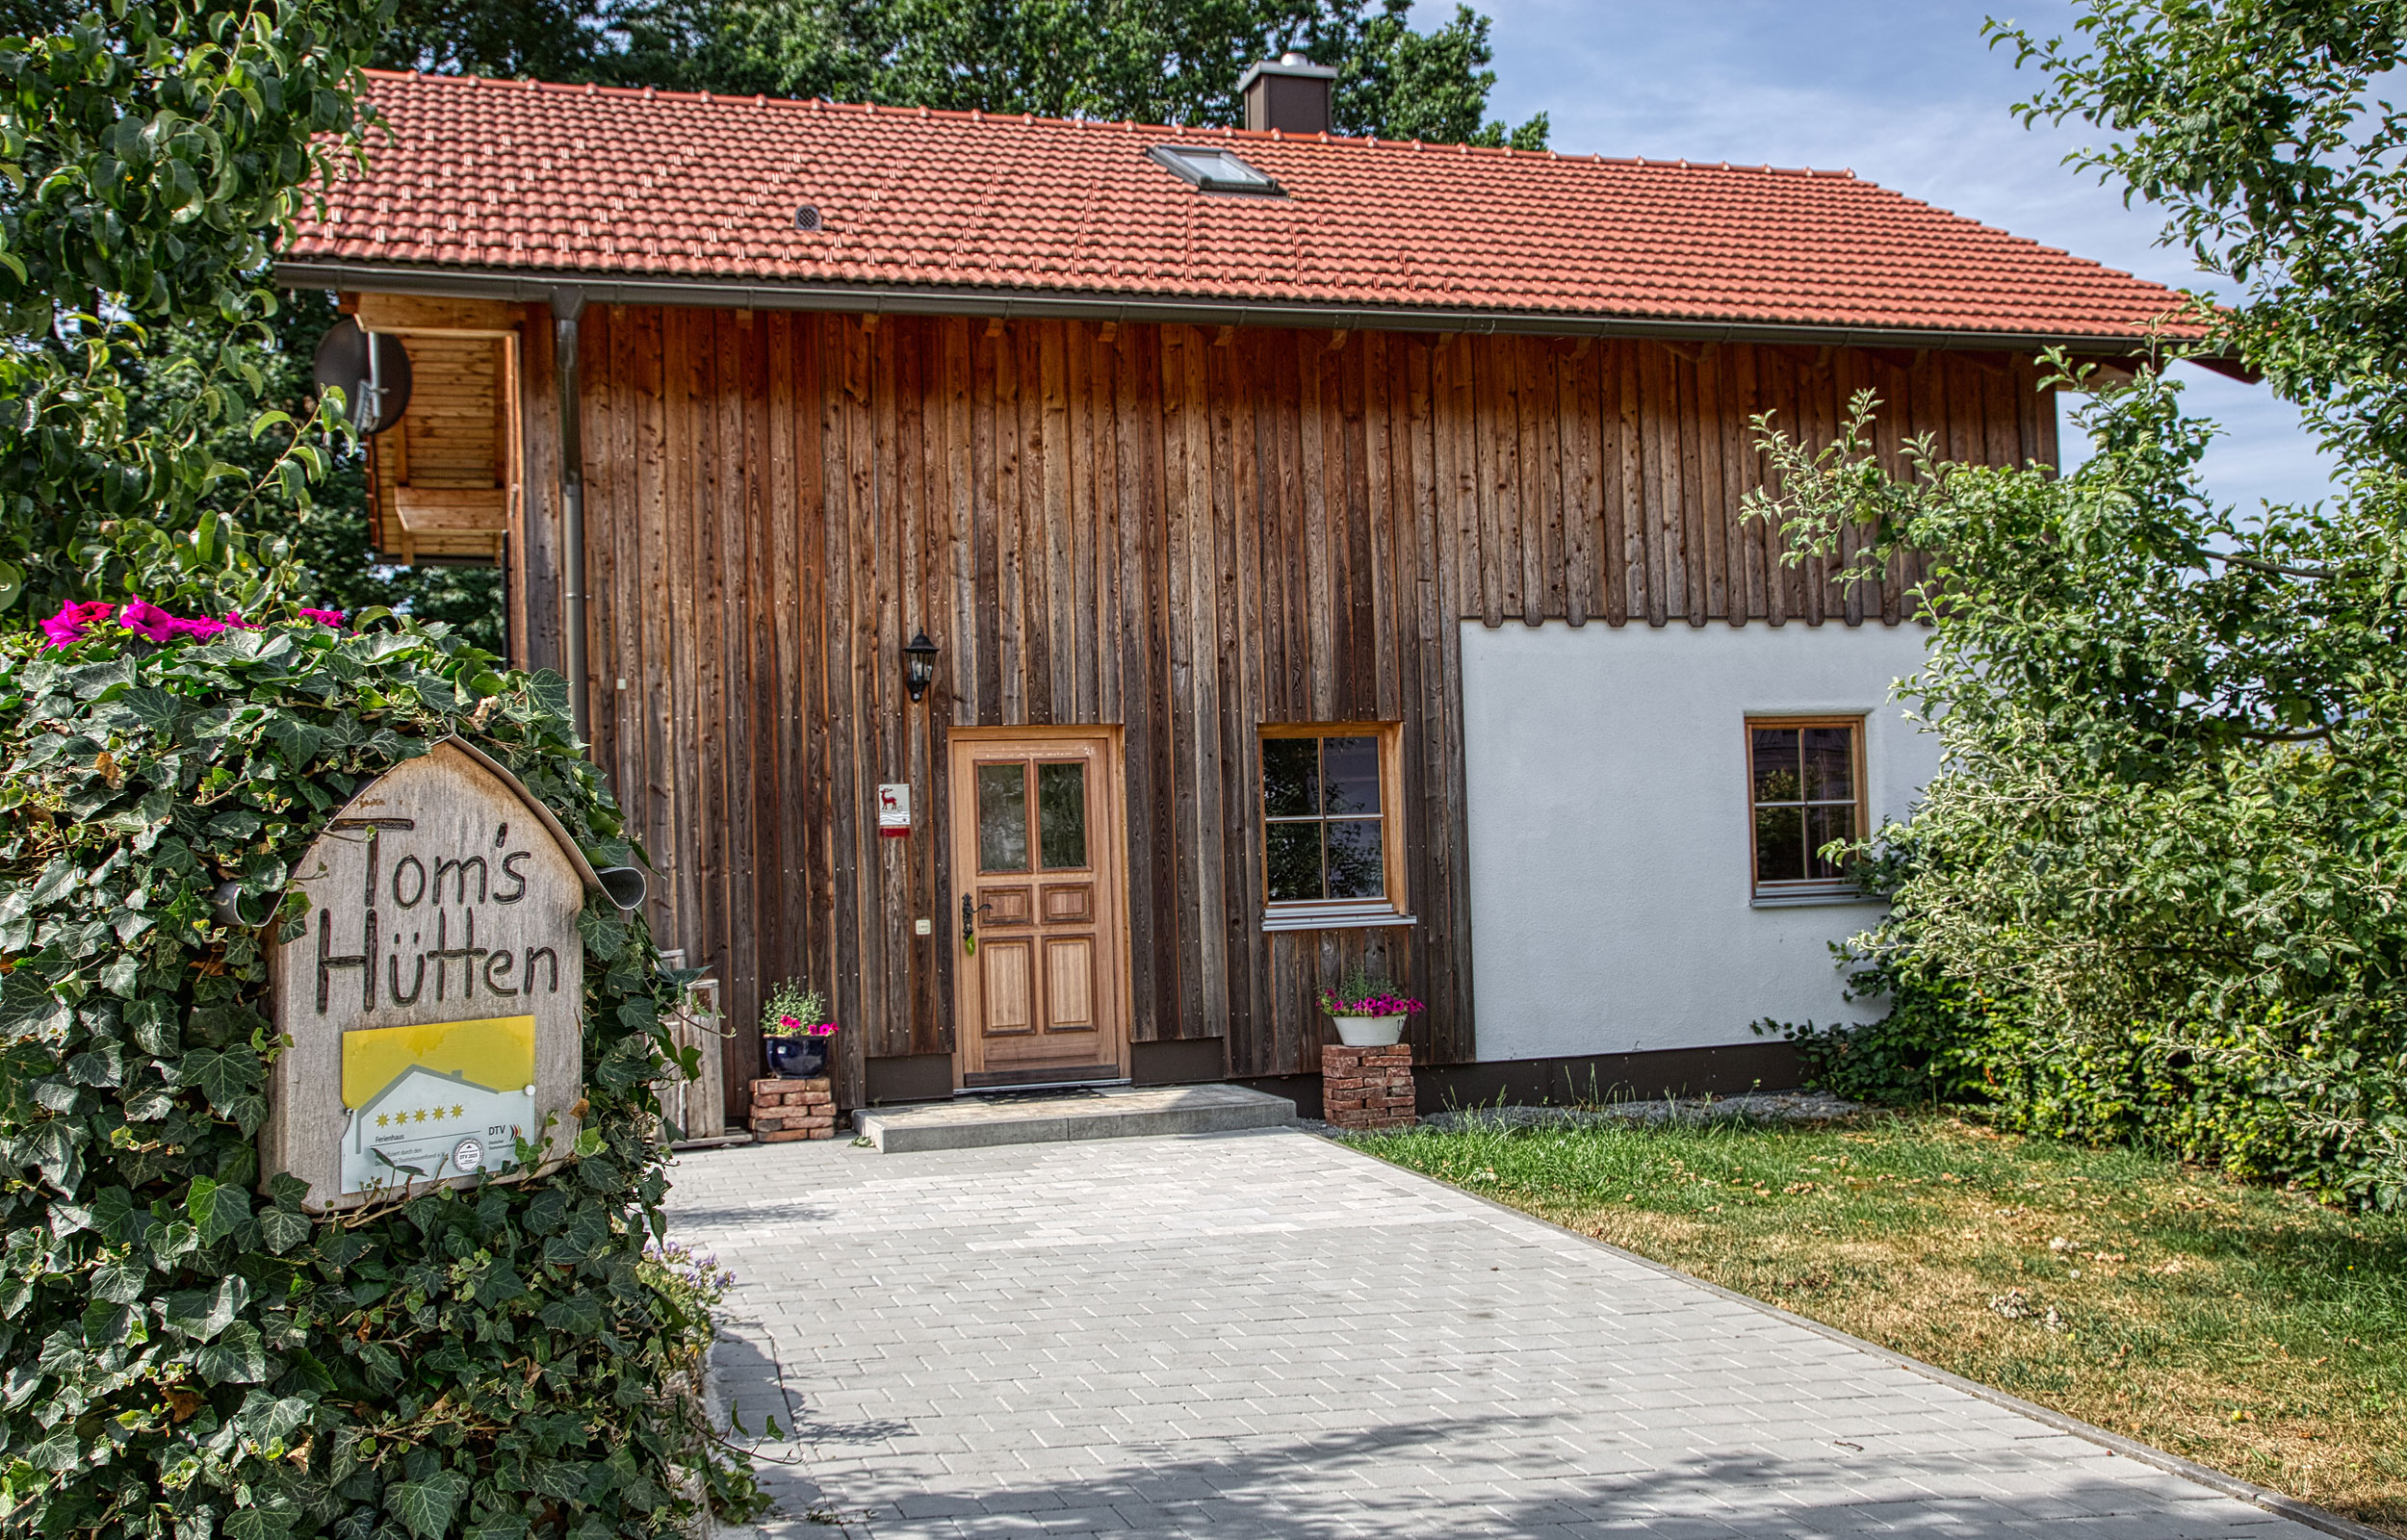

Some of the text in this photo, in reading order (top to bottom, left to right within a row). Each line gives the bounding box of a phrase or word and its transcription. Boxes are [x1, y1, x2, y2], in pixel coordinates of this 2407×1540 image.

[329, 818, 531, 909] Tom's
[316, 907, 557, 1014] Hütten
[375, 1134, 404, 1142] Ferienhaus
[489, 1125, 505, 1135] DTV
